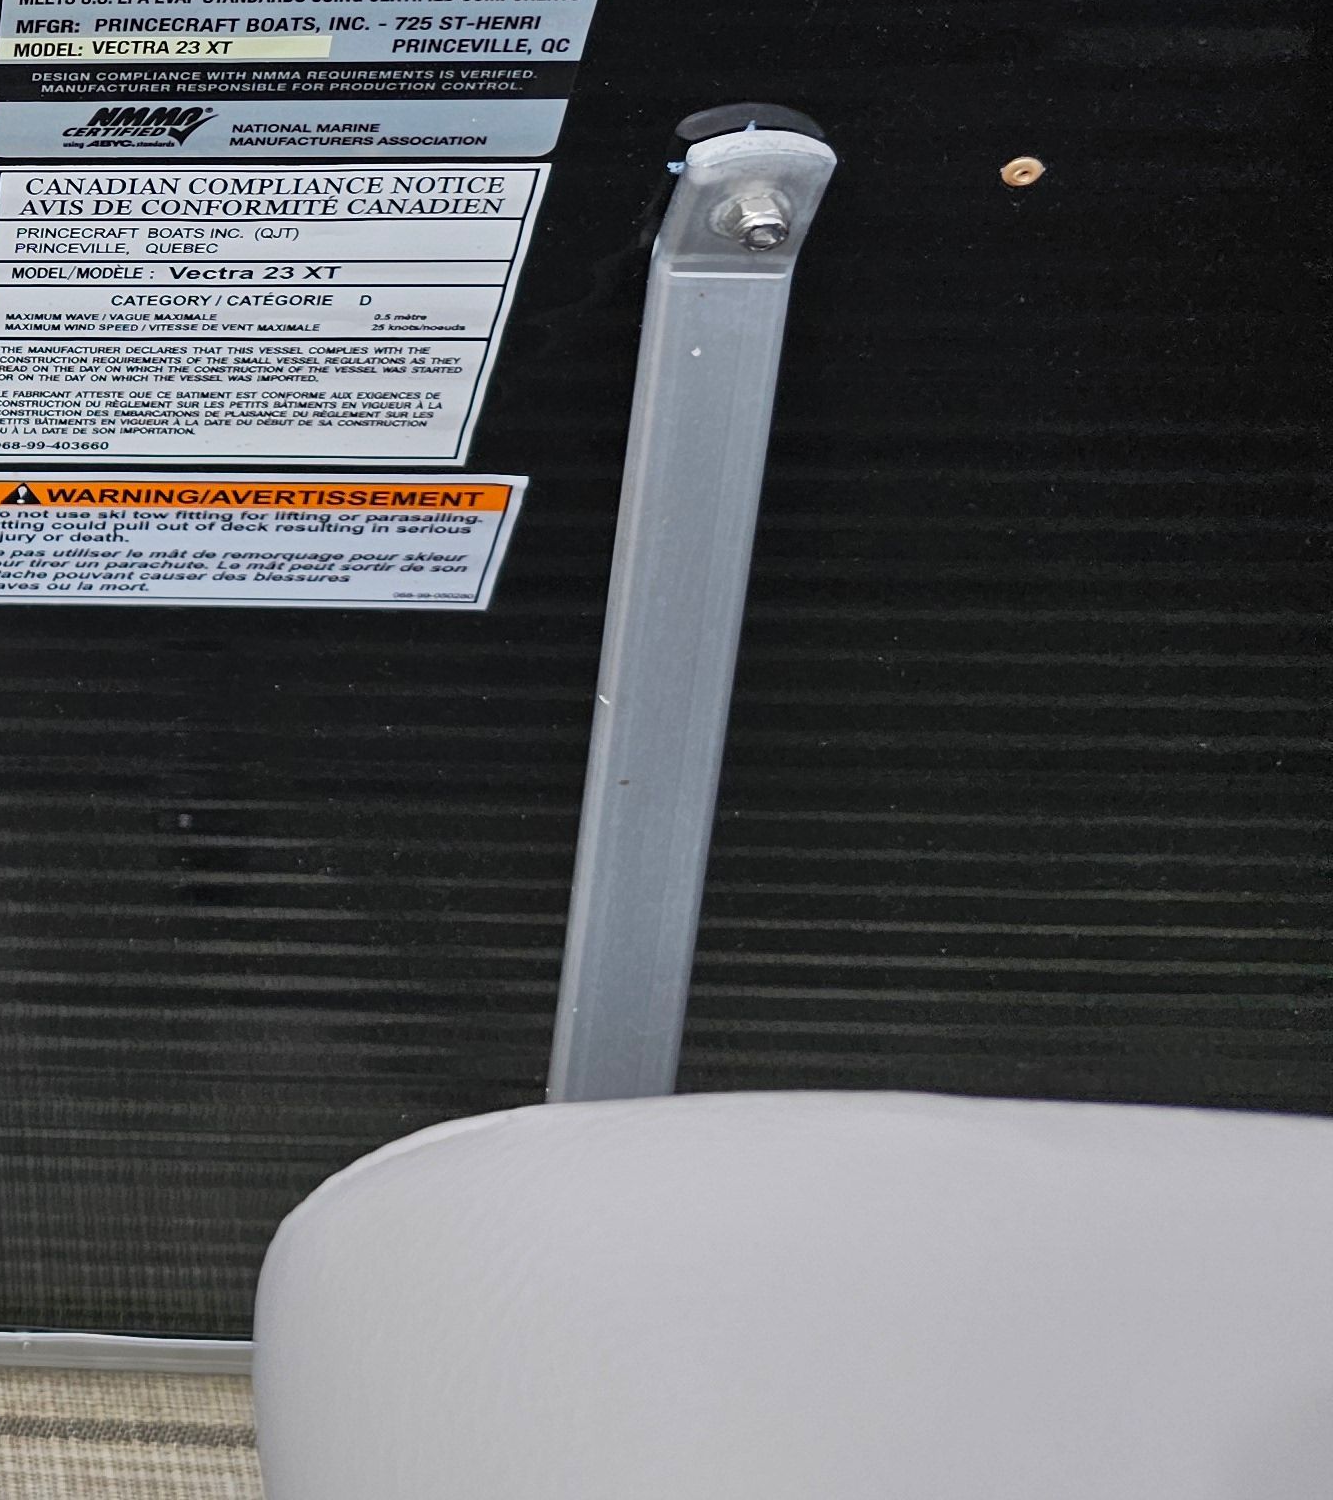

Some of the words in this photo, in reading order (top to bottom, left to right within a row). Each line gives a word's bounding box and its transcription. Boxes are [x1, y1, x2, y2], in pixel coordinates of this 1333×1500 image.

[15, 19, 81, 34] MFGR:
[94, 17, 241, 37] PRINCECRAFT
[245, 16, 321, 34] BOATS,
[328, 16, 370, 31] INC.
[395, 16, 434, 31] 725
[438, 15, 542, 31] ST-HENRI
[14, 42, 84, 58] MODEL:
[91, 40, 170, 55] VECTRA
[174, 40, 201, 55] 23
[203, 40, 234, 59] XT
[391, 38, 533, 55] PRINCEVILLE,
[540, 37, 571, 54] QC
[31, 72, 91, 82] DESIGN
[95, 71, 202, 81] COMPLIANCE
[206, 71, 247, 81] WITH
[251, 71, 302, 84] NMMA
[305, 70, 435, 84] REQUIREMENTS
[439, 70, 455, 84] IS
[458, 70, 538, 79] VERIFIED.
[40, 83, 171, 93] MANUFACTURER
[176, 82, 287, 92] RESPONSIBLE
[291, 82, 325, 92] FOR
[329, 82, 436, 91] PRODUCTION
[441, 80, 523, 91] CONTROL.
[61, 127, 168, 137] CERTIFIED
[231, 123, 312, 134] NATIONAL
[315, 123, 381, 133] MARINE
[228, 136, 374, 147] MANUFACTURERS
[375, 136, 488, 146] ASSOCIATION
[25, 177, 182, 196] CANADIAN
[188, 176, 384, 197] COMPLIANCE
[389, 176, 505, 194] NOTICE
[17, 199, 84, 216] AVIS
[90, 199, 133, 216] DE
[140, 196, 339, 216] CONFORMITÉ
[346, 198, 506, 215] CANADIEN
[16, 227, 140, 244] PRINCECRAFT
[147, 227, 206, 244] BOATS
[209, 227, 244, 244] INC.
[254, 227, 300, 242] (QJT)
[14, 242, 130, 255] PRINCEVILLE,
[145, 242, 219, 254] QUEBEC
[11, 265, 144, 280] MODEL/MODÈLE
[168, 266, 254, 280] Vectra
[262, 266, 295, 280] 23
[301, 265, 343, 280] XT
[110, 294, 213, 307] CATEGORY
[226, 292, 334, 307] CATÉGORIE
[358, 294, 373, 306] D
[46, 488, 485, 508] WARNING/AVERTISSEMENT
[14, 509, 50, 519] not
[55, 510, 94, 520] use
[97, 509, 127, 520] ski
[132, 510, 170, 521] tow
[175, 509, 234, 524] fitting
[239, 510, 269, 522] for
[274, 510, 332, 525] lifting
[334, 513, 361, 523] or
[364, 512, 486, 526] parasailing.
